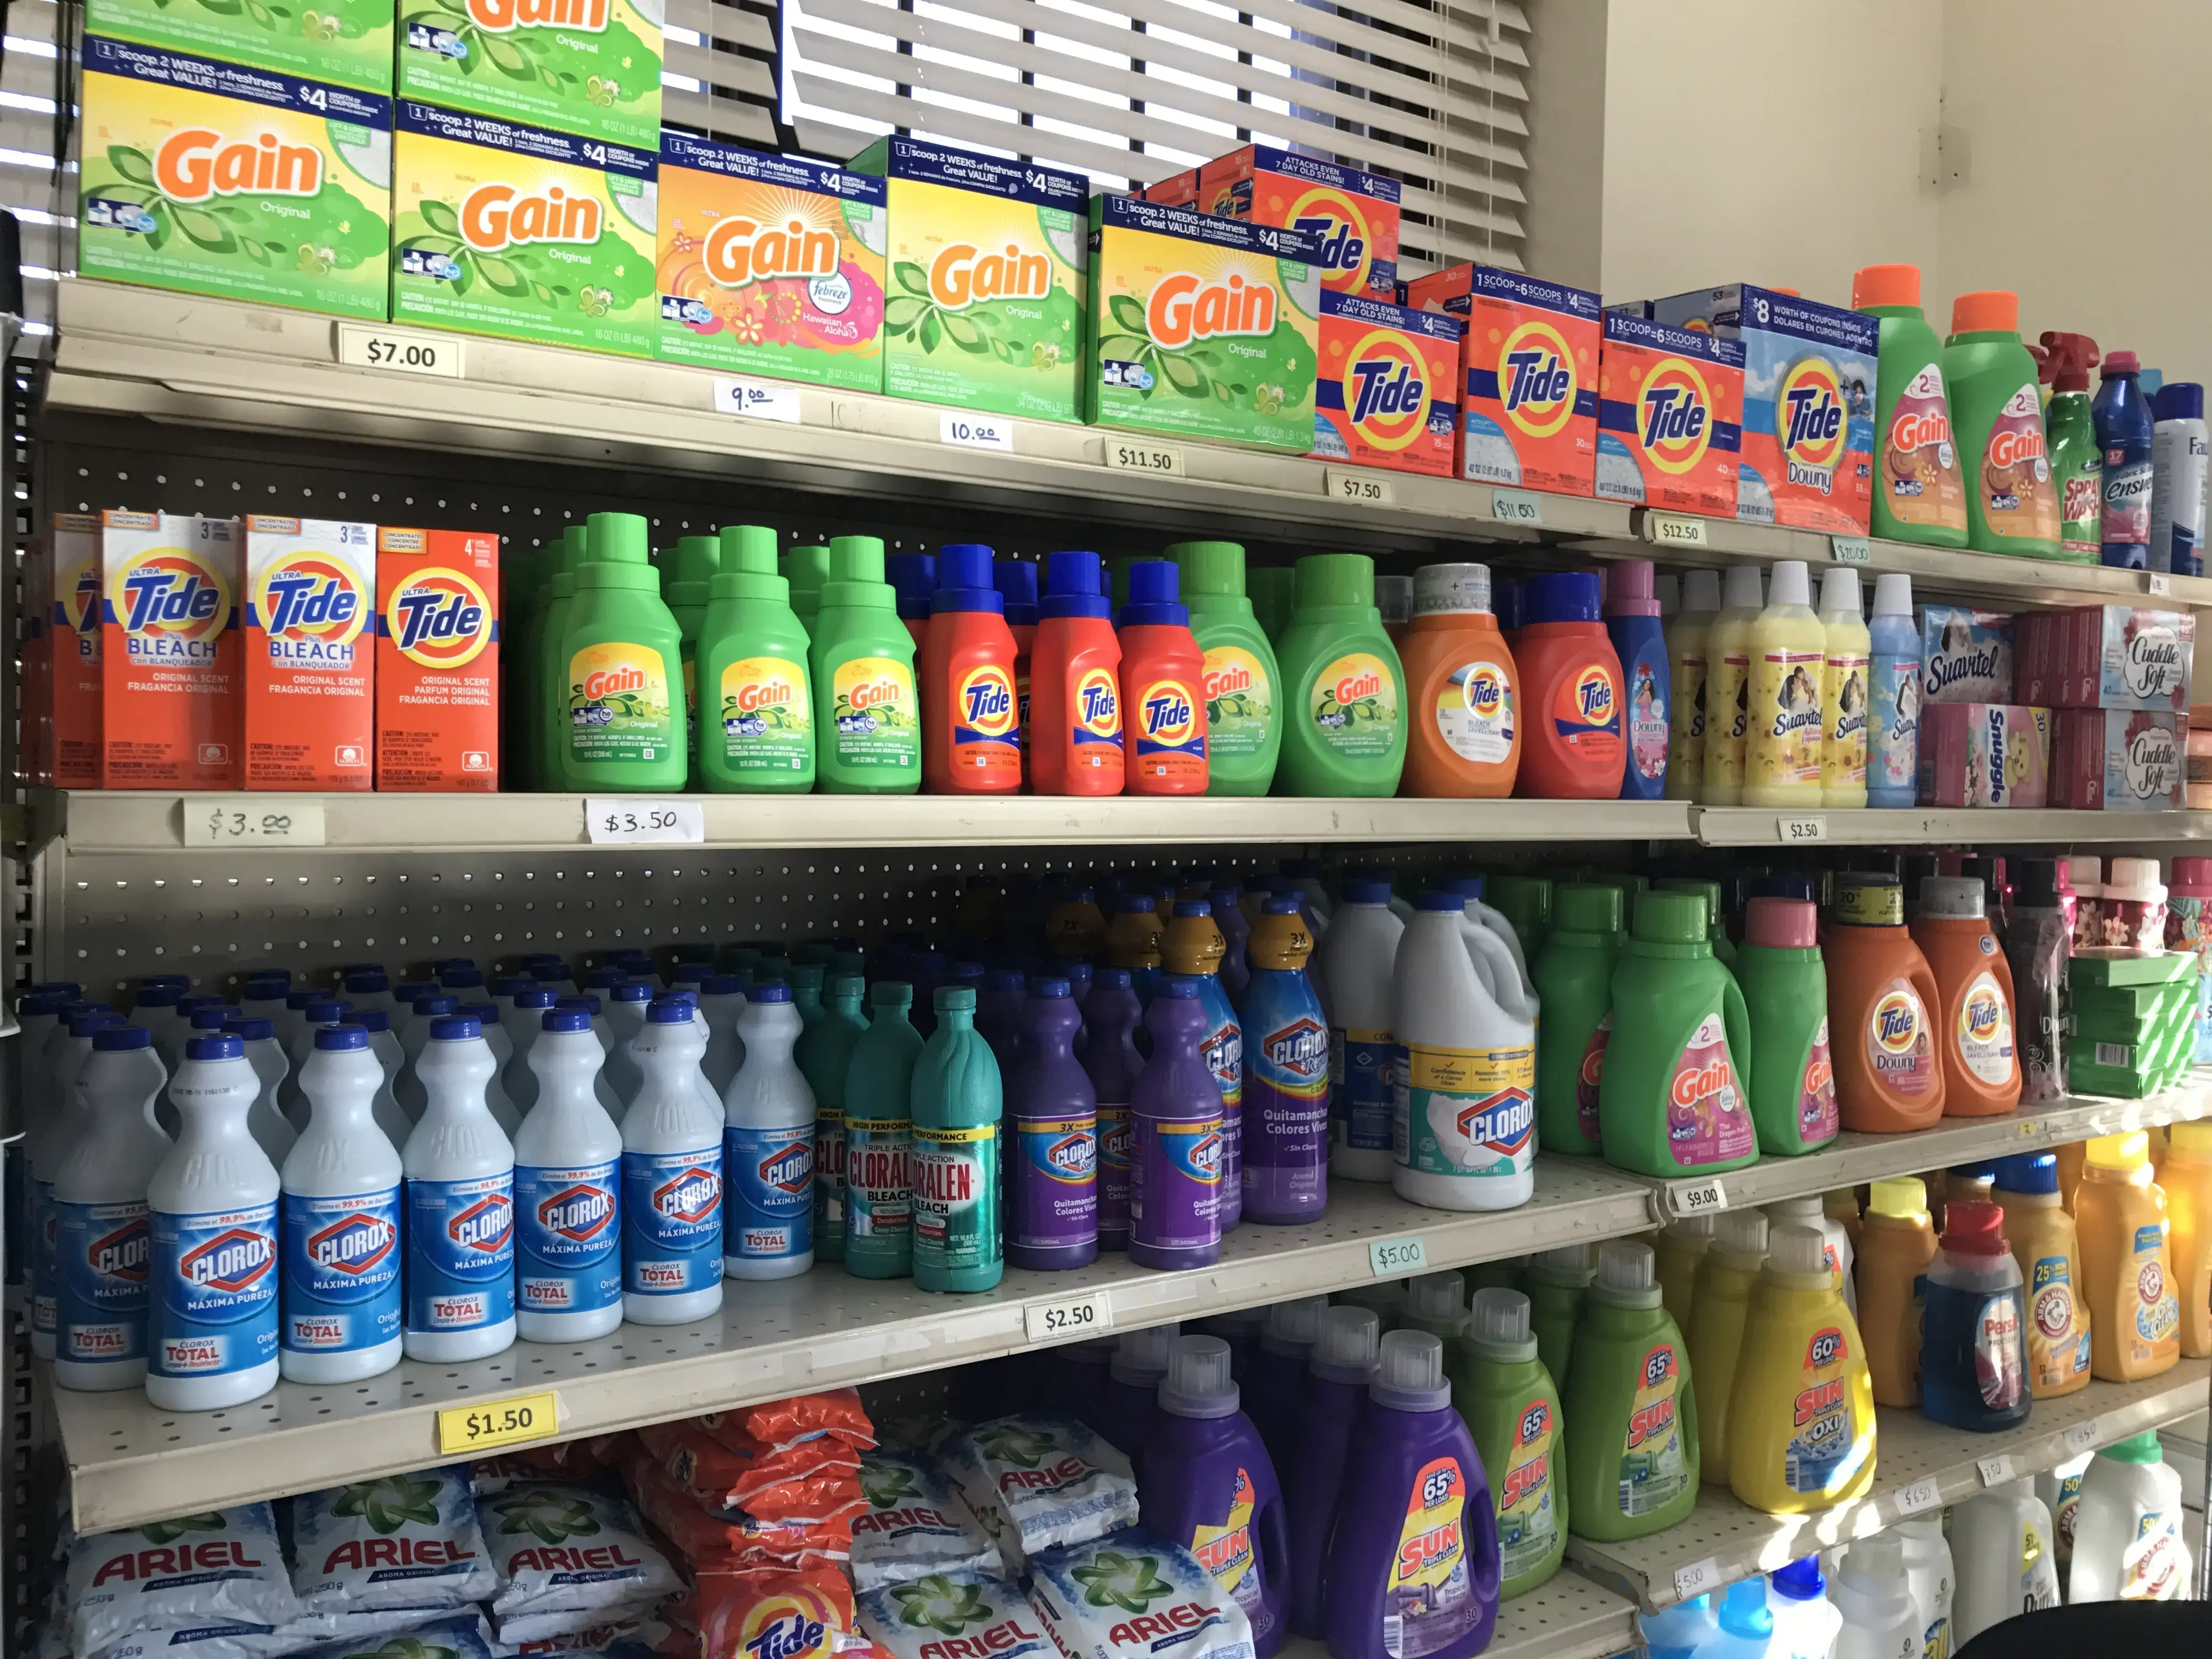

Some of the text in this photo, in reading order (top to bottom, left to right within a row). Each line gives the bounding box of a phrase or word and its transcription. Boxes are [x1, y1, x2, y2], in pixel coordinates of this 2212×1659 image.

[442, 124, 513, 147] Great VALUE!
[465, 117, 472, 127] 2
[473, 120, 511, 136] WEEKS
[156, 130, 321, 199] Gain
[583, 144, 606, 164] $4
[261, 201, 311, 220] Original
[462, 185, 599, 248] Gain
[549, 249, 591, 265] Original
[707, 220, 836, 283] Gain
[931, 244, 1049, 306] Gain
[814, 283, 848, 298] febreze
[803, 313, 843, 326] Hawaiian
[1006, 306, 1042, 319] Original
[1149, 274, 1276, 345] Gain
[1342, 304, 1359, 314] DAY
[1360, 308, 1374, 318] OLD
[1376, 311, 1404, 325] STAINS!
[1345, 298, 1400, 316] ATTACKS EVEN
[1753, 298, 1769, 323] $8
[1774, 305, 1861, 333] WORTH OF COUPONS INSIDE
[825, 325, 849, 336] Aloha
[1774, 317, 1804, 330] DOLARES
[1815, 324, 1844, 340] CUPONES
[1845, 332, 1872, 346] ADENTRO
[368, 339, 436, 367] $7.00
[1228, 343, 1266, 359] Original
[1351, 361, 1424, 425] Tide
[1505, 351, 1570, 413] Tide
[1920, 375, 1929, 393] 2
[732, 387, 774, 410] 9.00
[1642, 386, 1706, 449] Tide
[1784, 387, 1842, 452] Tide
[951, 422, 1000, 441] 10.00
[1893, 413, 1948, 453] Gain
[1119, 448, 1172, 470] $11.50
[1990, 430, 2043, 469] Gain
[2109, 450, 2121, 461] 17
[1344, 480, 1381, 499] $7.50
[1788, 462, 1832, 494] Downy
[1663, 524, 1699, 540] $12.50
[1837, 543, 1869, 561] $20.00
[272, 571, 302, 581] ULTRA
[125, 573, 219, 633] Tide
[402, 588, 430, 596] ULTRA
[267, 577, 357, 636] Tide
[397, 592, 483, 650] Tide
[128, 639, 216, 657] BLEACH
[269, 642, 353, 661] BLEACH
[2132, 636, 2179, 665] Cuddle
[290, 660, 350, 670] BLANQUEADOR
[1926, 646, 1998, 695] Suavitel
[2138, 664, 2165, 692] Soft
[269, 685, 365, 696] FRAGANCIA ORIGINAL
[293, 675, 365, 686] ORIGINAL SCENT
[415, 686, 490, 696] PARFUM ORIGINAL
[421, 676, 489, 687] ORIGINAL SCENT
[584, 669, 644, 699] Gain
[1204, 668, 1251, 701] Gain
[1335, 674, 1379, 704] Gain
[1470, 679, 1499, 707] Tide
[399, 696, 490, 706] FRAGANCIA ORIGINAL
[738, 683, 791, 710] Gain
[850, 682, 899, 709] Gain
[966, 682, 1010, 723] Tide
[1082, 686, 1115, 723] Tide
[1581, 682, 1611, 716] Tide
[630, 720, 658, 729] Original
[1146, 697, 1190, 736] Tide
[1634, 720, 1666, 737] Downy
[1774, 708, 1822, 736] Suavitel
[1990, 709, 2004, 803] Snuggle
[2132, 737, 2176, 766] Cuddle
[2138, 765, 2164, 792] Soft
[208, 808, 291, 839] $3.00
[604, 811, 676, 833] $3.50
[1791, 823, 1817, 838] $2.50
[1881, 1008, 1913, 1042] Tide
[1969, 1002, 1997, 1032] Tide
[1273, 1030, 1328, 1067] CLOROX
[1877, 1055, 1916, 1071] Downy
[1673, 1062, 1729, 1107] Gain
[1266, 1123, 1309, 1135] Colores
[1469, 1098, 1532, 1146] CLOROX
[915, 1131, 967, 1141] PERFORMANCE
[1055, 1138, 1097, 1167] CLOROX
[768, 1151, 813, 1187] CLOROX
[662, 1175, 719, 1217] CLOROX
[867, 1190, 913, 1202] BLEACH
[1688, 1189, 1718, 1207] $9.00
[458, 1200, 513, 1248] CLOROX
[546, 1190, 611, 1233] CLOROX
[317, 1219, 390, 1266] CLOROX
[543, 1239, 612, 1253] MÁXIMA PUREZA
[746, 1235, 785, 1246] TOTAL
[192, 1235, 272, 1286] CLOROX
[1378, 1244, 1420, 1267] $5.00
[314, 1272, 392, 1289] MÁXIMA PUREZA
[2036, 1265, 2049, 1282] 25
[447, 1296, 478, 1305] CLOROX
[296, 1323, 341, 1337] TOTAL
[1046, 1305, 1094, 1330] $2.50
[166, 1347, 218, 1362] TOTAL
[1795, 1378, 1843, 1426] SUN
[467, 1408, 532, 1440] $1.50
[1628, 1395, 1674, 1449] SUN
[1812, 1415, 1839, 1441] OXI
[1000, 1457, 1097, 1492] ARIEL
[1502, 1452, 1548, 1510] SUN
[851, 1508, 961, 1536] ARIEL
[323, 1538, 476, 1575] ARIEL
[508, 1545, 641, 1577] ARIEL
[1400, 1519, 1459, 1579] SUN
[1423, 1546, 1457, 1567] TRIPLE CLEAN
[92, 1541, 262, 1588] ARIEL
[378, 1571, 404, 1579] AROMA
[314, 1582, 334, 1593] 250
[1444, 1583, 1466, 1596] Tropical
[1445, 1592, 1466, 1603] Breeze
[1109, 1602, 1222, 1646] ARIEL
[1467, 1608, 1476, 1621] 30
[747, 1614, 823, 1659] Tide
[919, 1619, 1042, 1659] ARIEL
